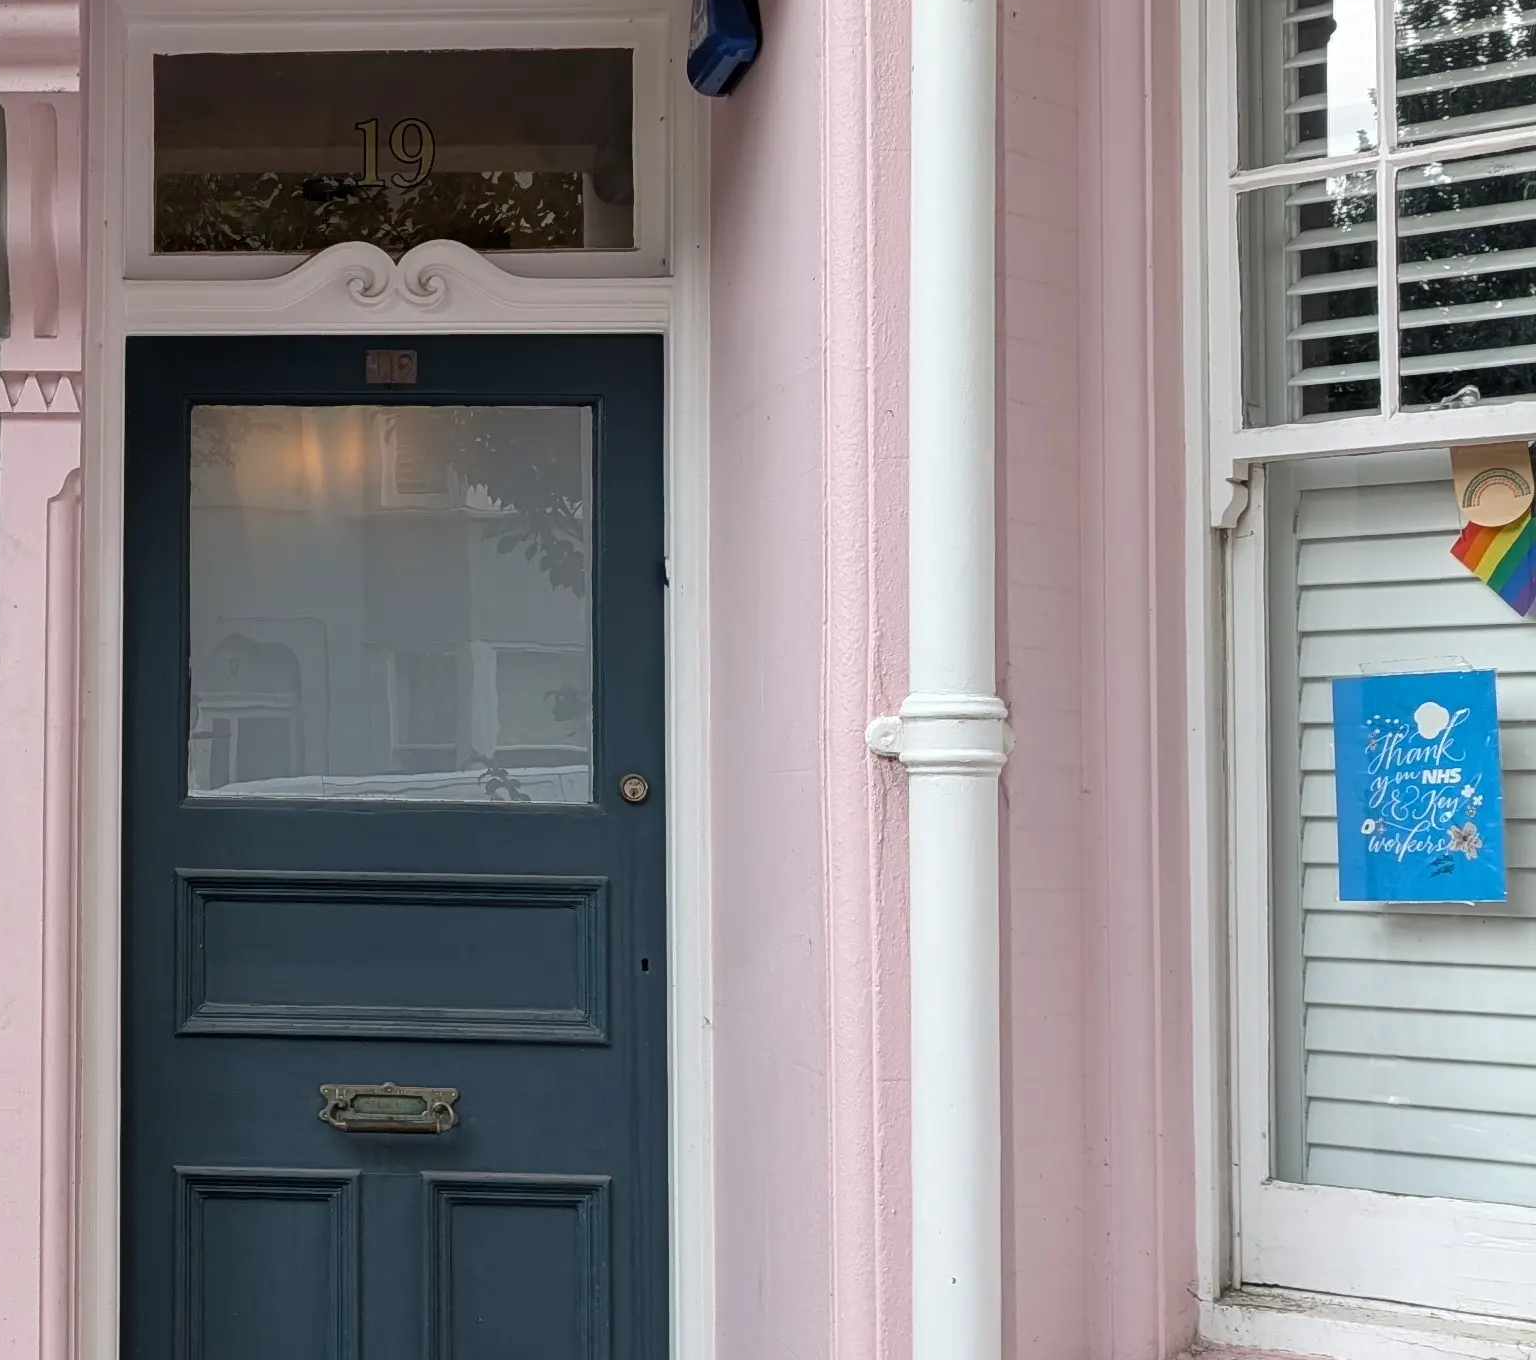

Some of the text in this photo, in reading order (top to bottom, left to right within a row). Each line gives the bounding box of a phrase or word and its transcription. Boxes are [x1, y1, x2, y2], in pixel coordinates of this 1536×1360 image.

[354, 117, 436, 189] 19
[1365, 708, 1470, 774] Thank
[1369, 767, 1462, 808] you NHS
[1381, 785, 1460, 831] & Key
[1368, 820, 1449, 862] workers
